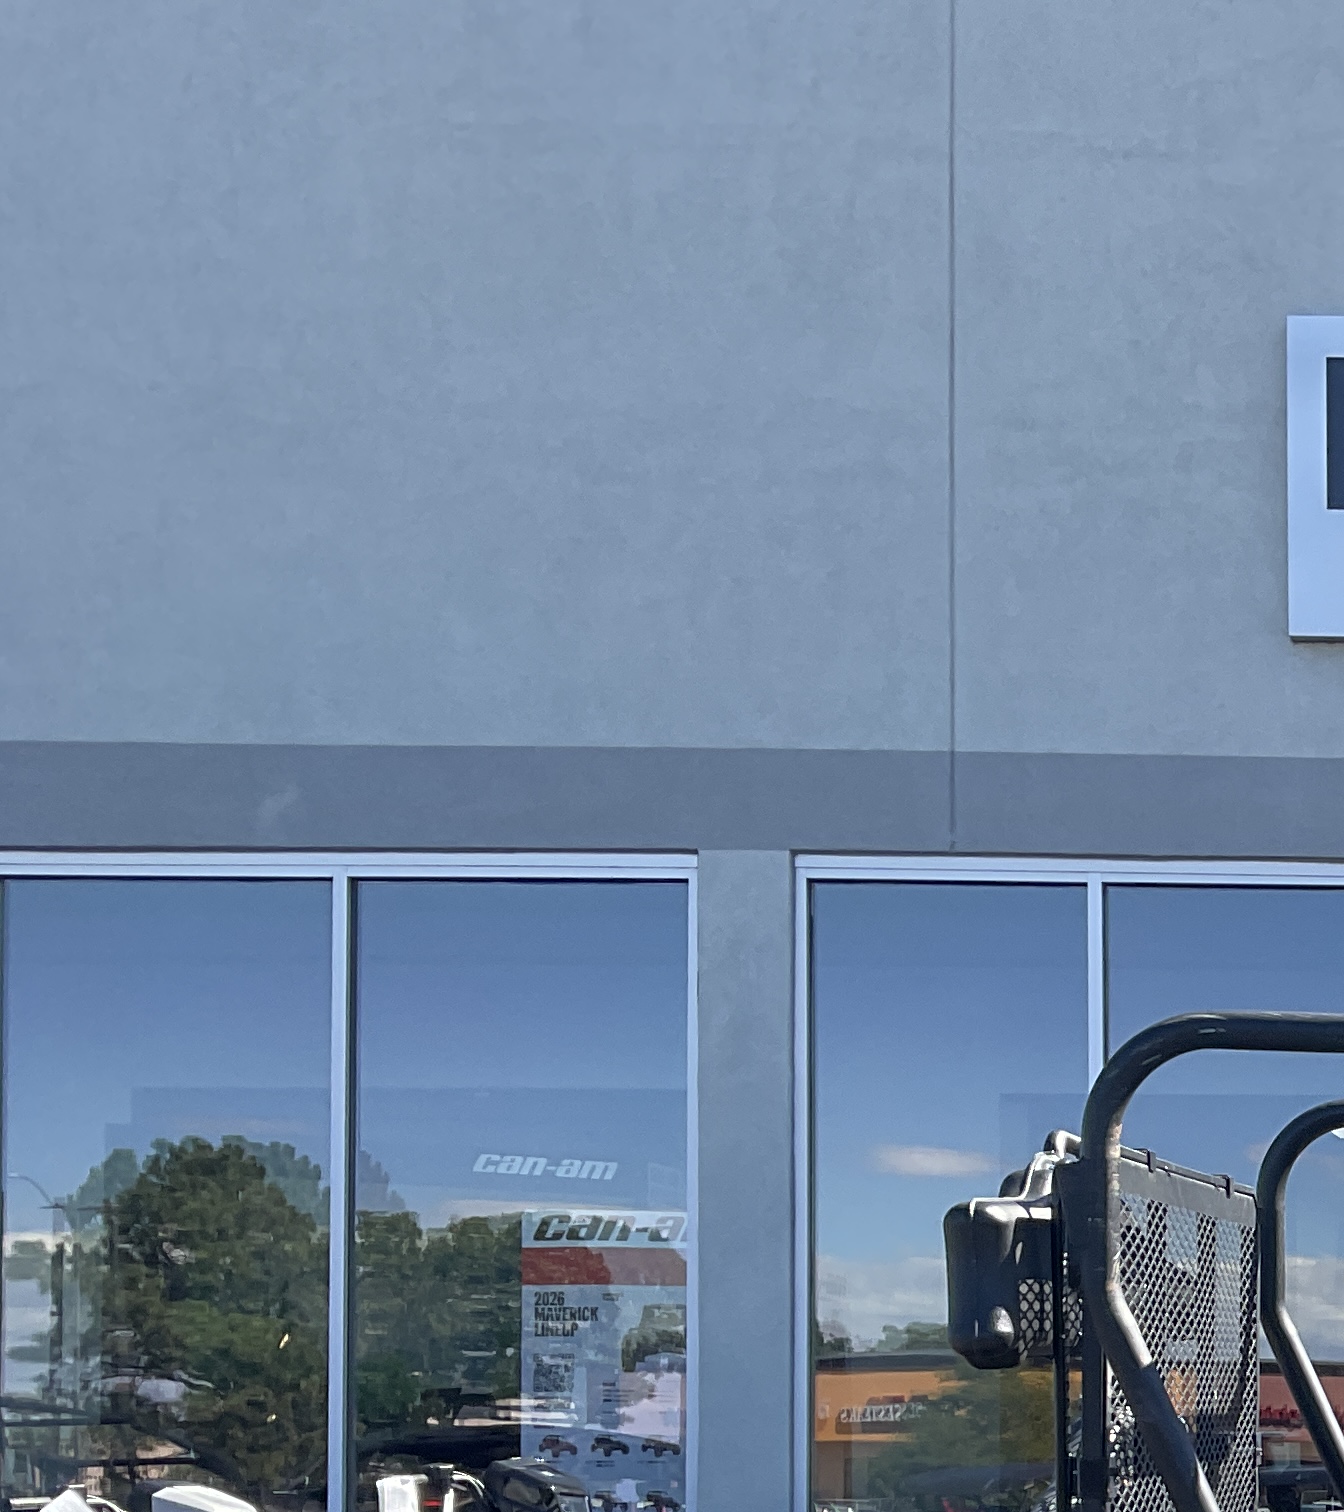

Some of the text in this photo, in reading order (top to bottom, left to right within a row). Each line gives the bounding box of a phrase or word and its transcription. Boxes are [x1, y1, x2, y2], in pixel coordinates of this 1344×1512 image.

[472, 1154, 618, 1180] can-am
[533, 1215, 687, 1242] can-a
[534, 1291, 565, 1306] 2026
[534, 1306, 599, 1322] MAVERICK
[534, 1322, 578, 1337] LINEUP
